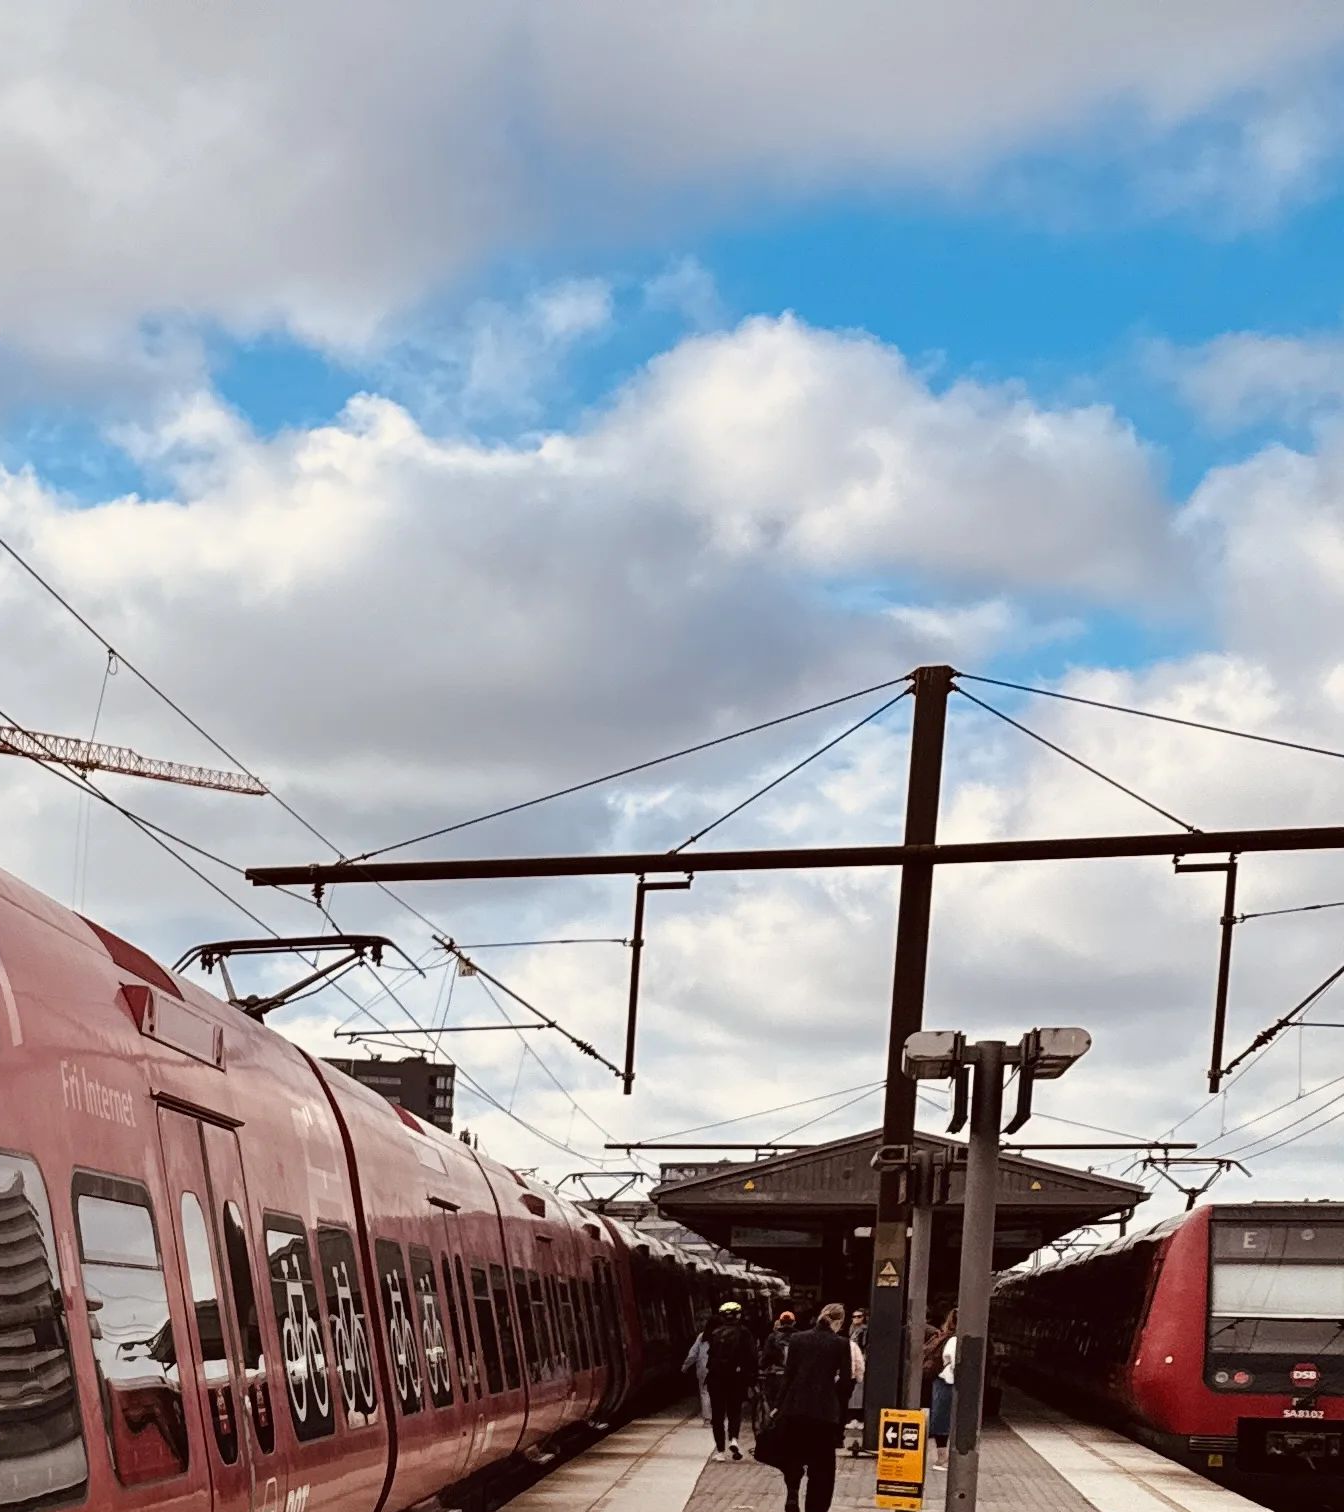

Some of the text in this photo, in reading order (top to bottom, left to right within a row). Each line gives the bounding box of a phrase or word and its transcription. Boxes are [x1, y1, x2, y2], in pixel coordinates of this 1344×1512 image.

[59, 1060, 137, 1128] Fri Internet
[1242, 1231, 1258, 1249] E
[1292, 1370, 1317, 1380] DSB
